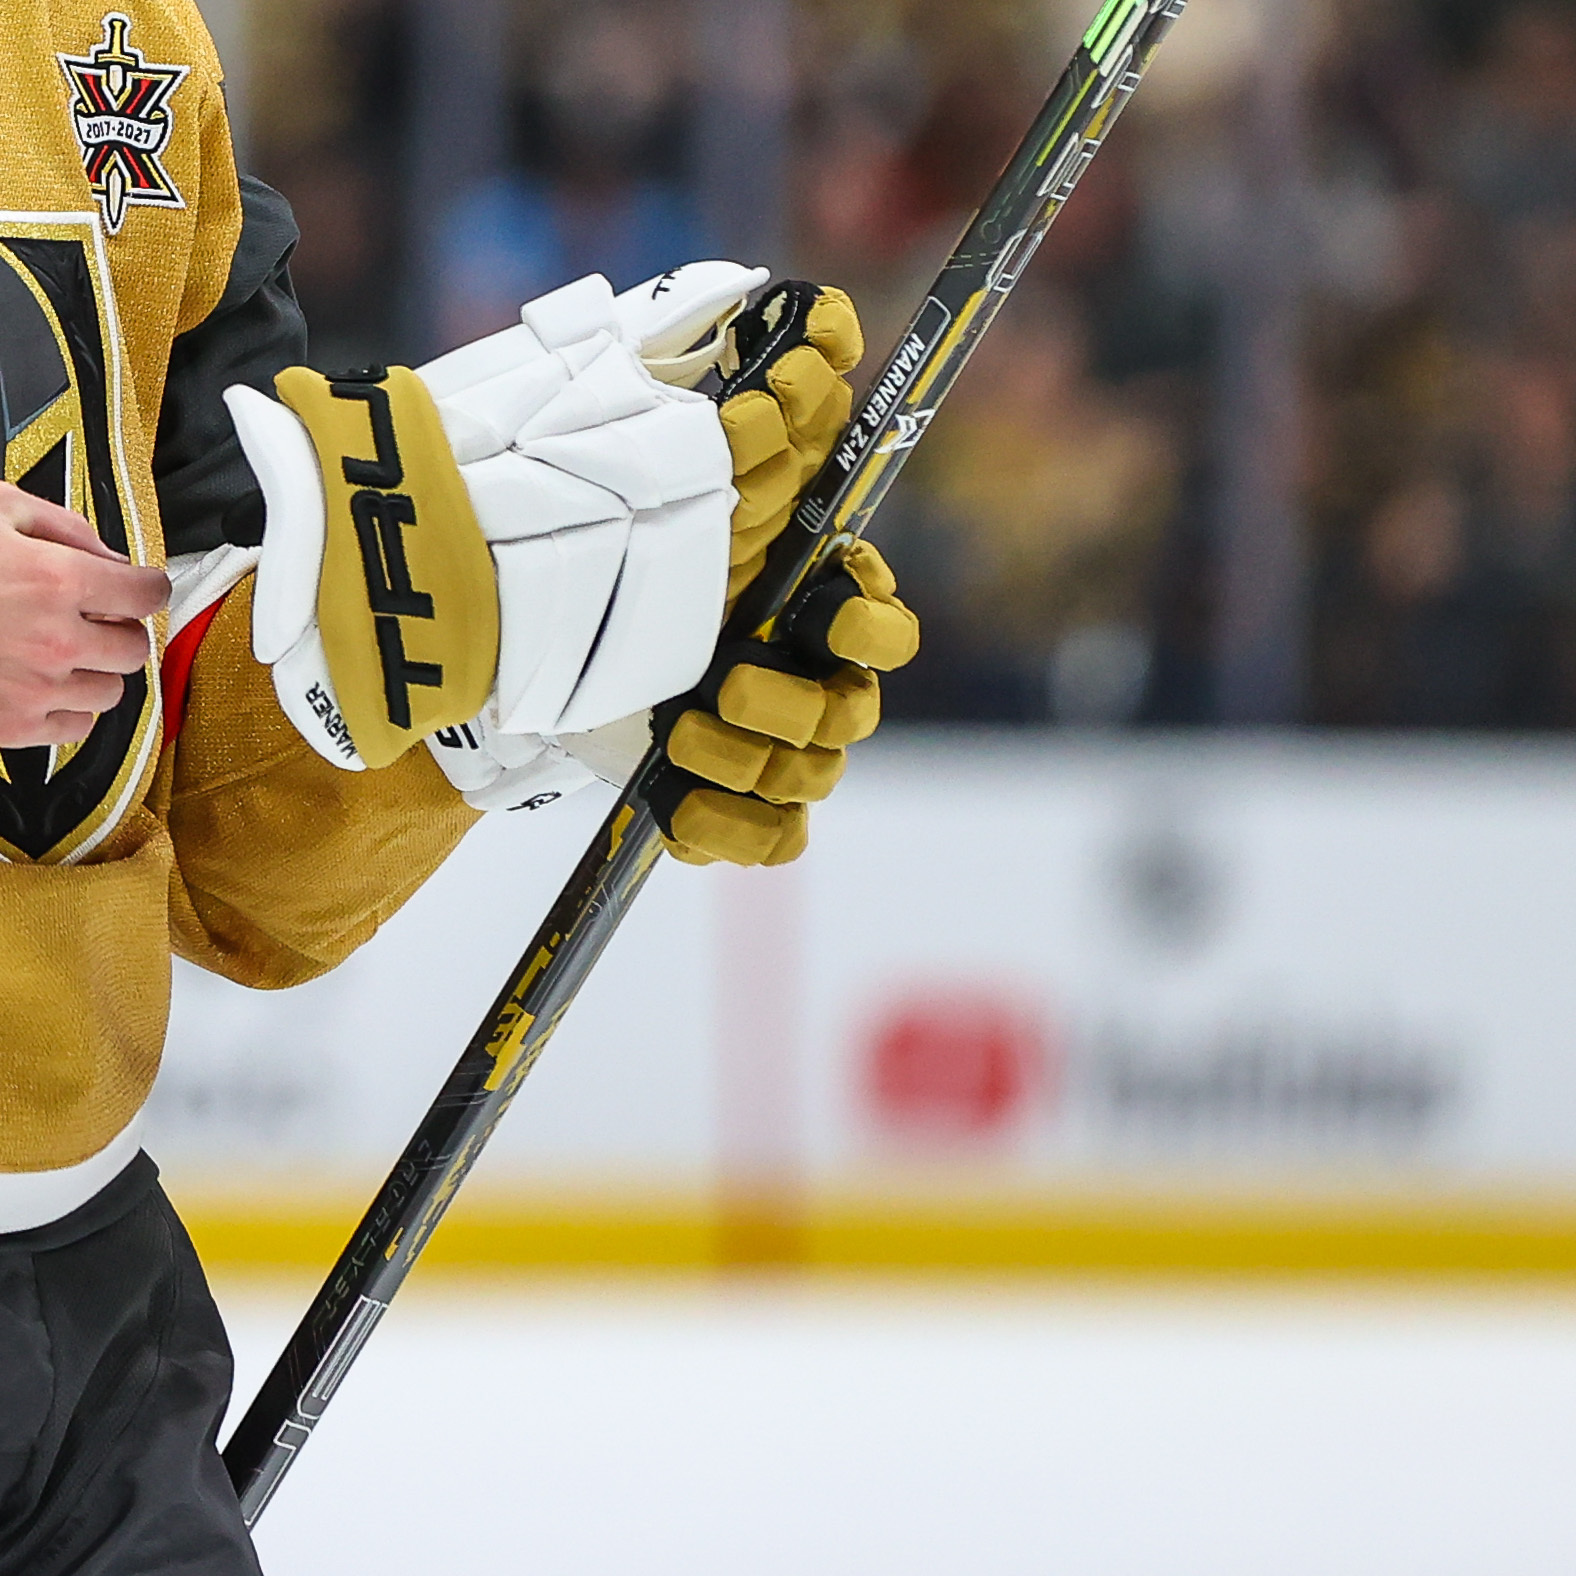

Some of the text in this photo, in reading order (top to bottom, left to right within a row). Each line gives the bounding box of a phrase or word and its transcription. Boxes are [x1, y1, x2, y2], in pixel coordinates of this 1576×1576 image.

[835, 332, 926, 472] MARNER Z-M
[305, 681, 360, 761] MARNER
